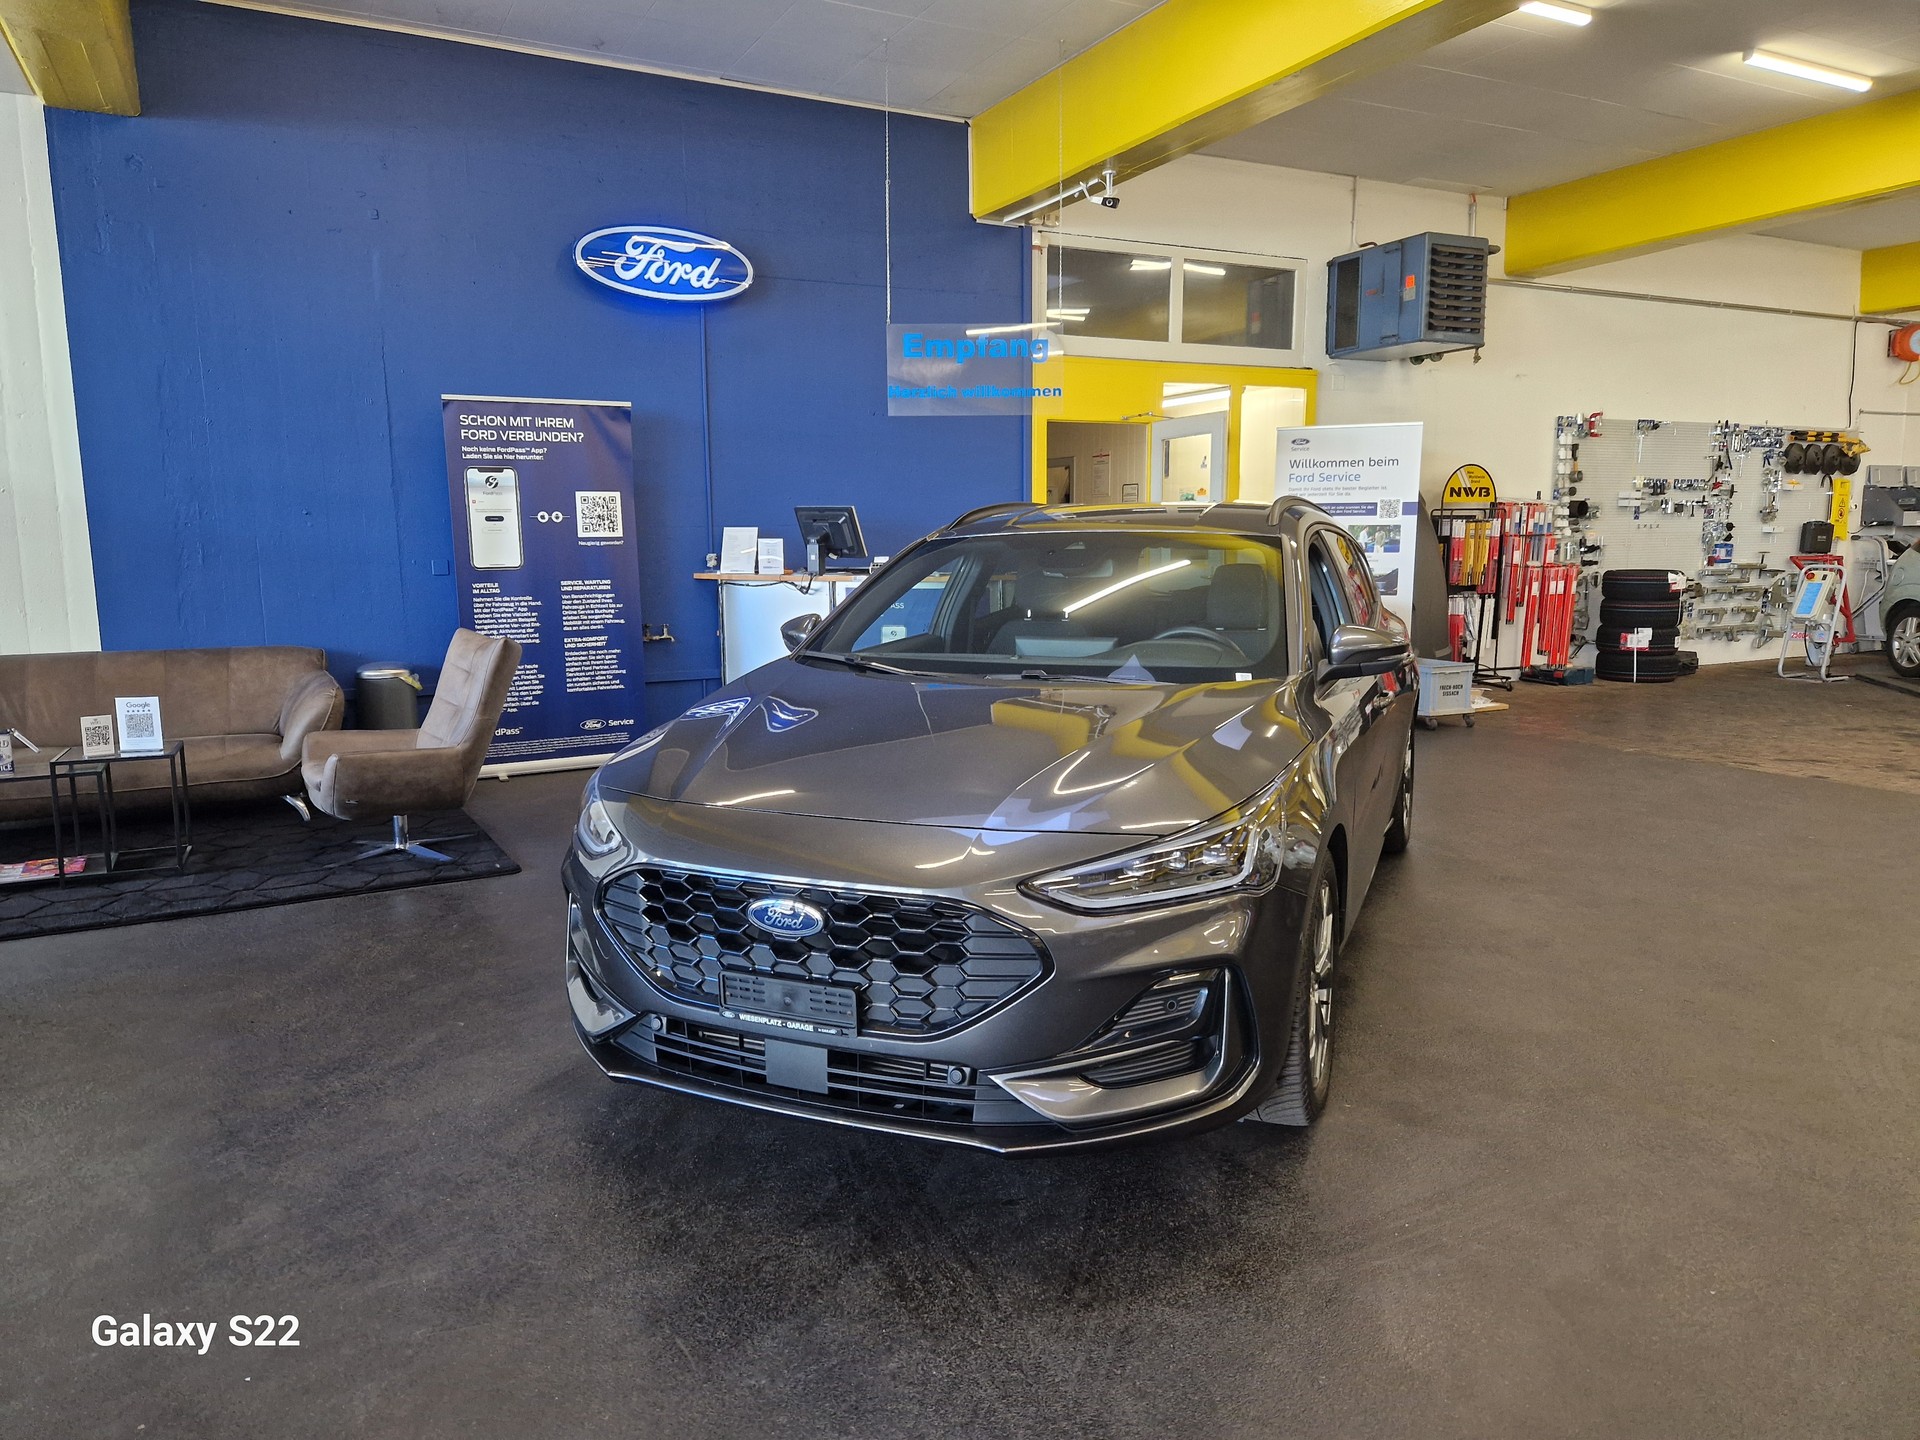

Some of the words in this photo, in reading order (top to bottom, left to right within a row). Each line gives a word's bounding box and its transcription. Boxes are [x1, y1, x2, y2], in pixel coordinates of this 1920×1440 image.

[614, 235, 721, 290] Ford
[903, 333, 1050, 364] Empfang
[888, 386, 956, 399] Herzlich
[962, 385, 1062, 398] willkommen
[460, 415, 506, 427] SCHON
[510, 416, 532, 427] MIT
[535, 417, 574, 428] IHREM
[461, 430, 497, 440] FORD
[500, 431, 584, 442] VERBUNDEN?
[1289, 459, 1364, 469] Willkommen
[1368, 457, 1399, 467] beim
[1288, 473, 1314, 483] Ford
[1319, 472, 1361, 482] Service
[1450, 487, 1490, 497] NWB
[764, 907, 805, 929] Ford
[739, 1013, 781, 1026] WIESENPLATZ
[787, 1021, 813, 1032] GARAGE
